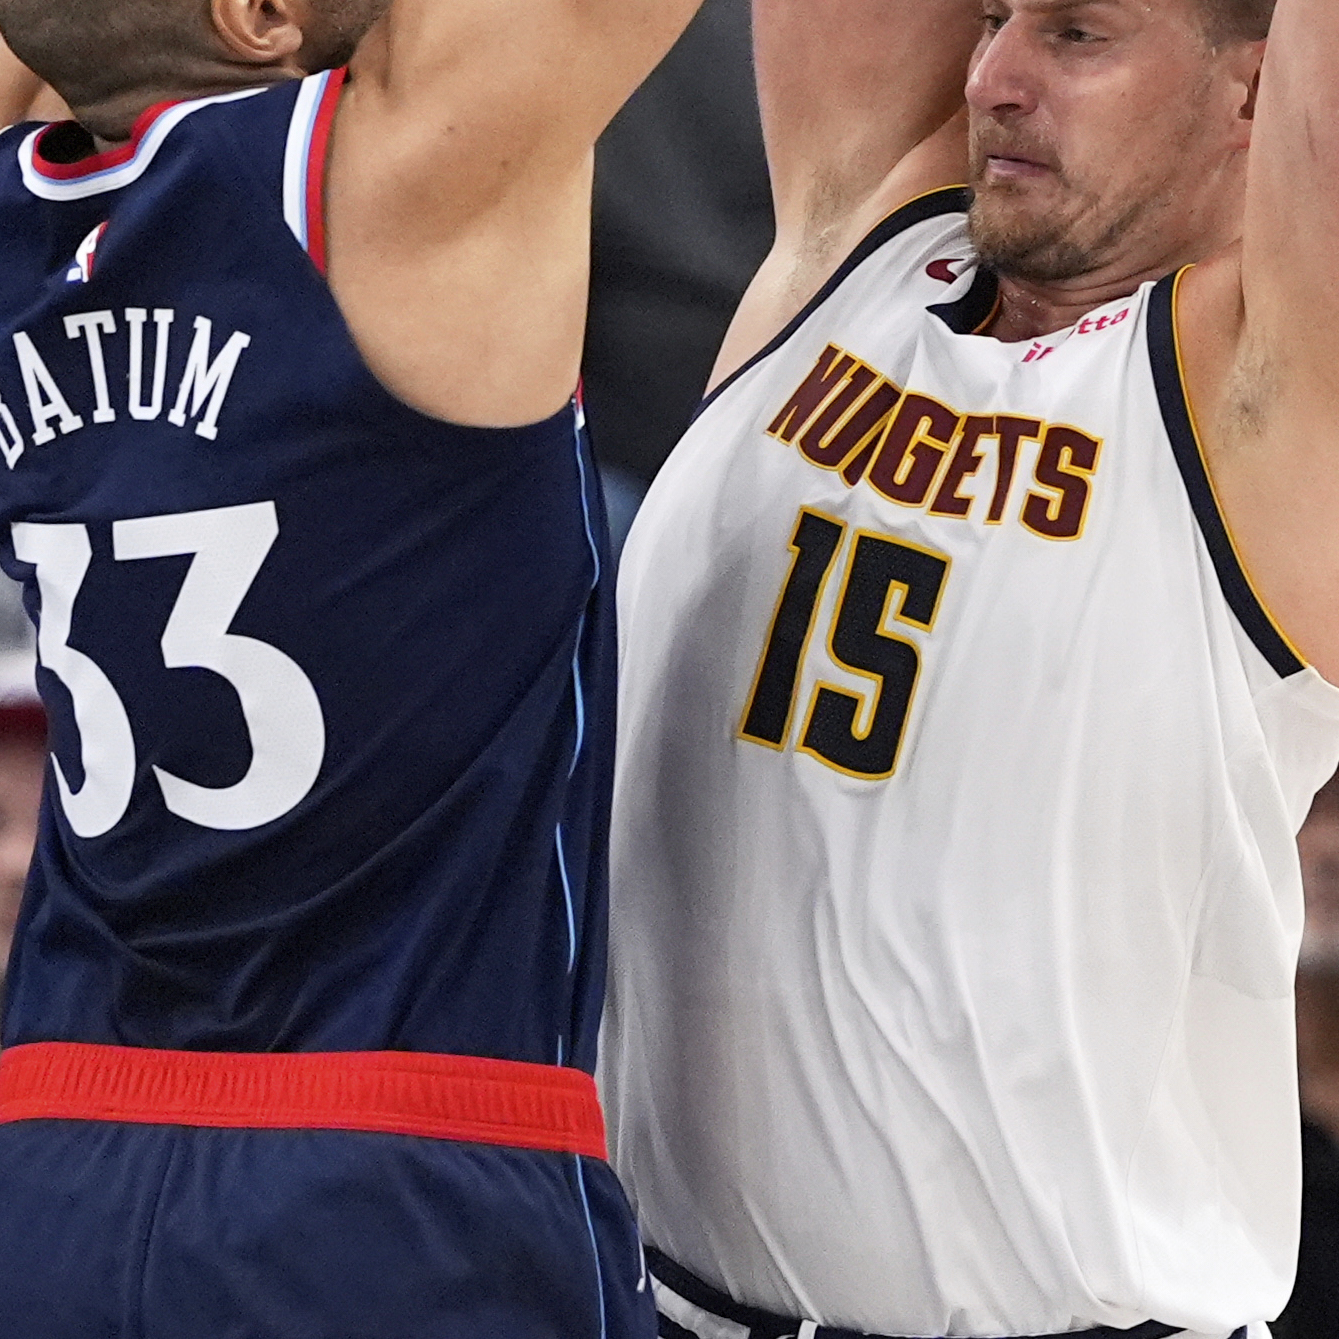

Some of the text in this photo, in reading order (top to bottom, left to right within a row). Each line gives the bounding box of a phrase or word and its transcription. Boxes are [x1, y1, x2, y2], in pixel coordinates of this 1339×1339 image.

[765, 342, 1103, 542] NUGETS
[11, 500, 326, 839] 33
[737, 504, 953, 781] 15
